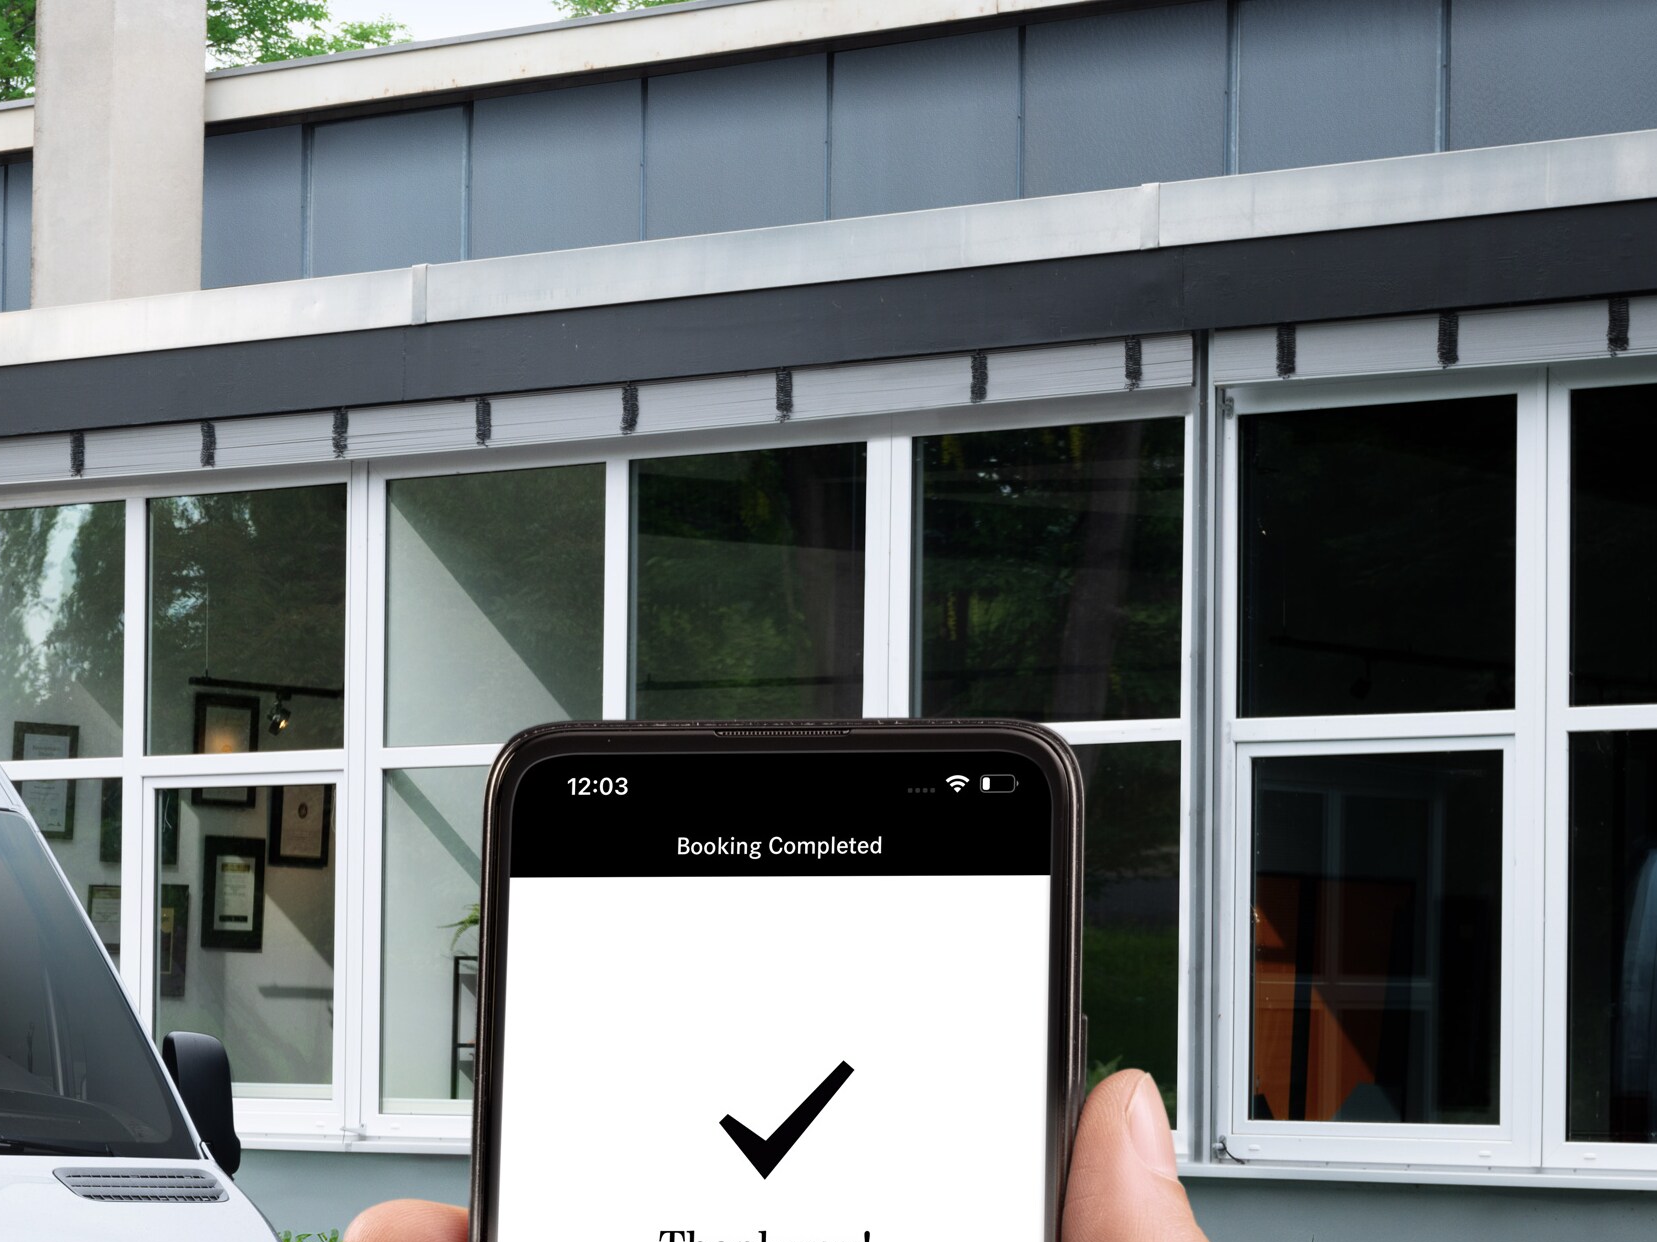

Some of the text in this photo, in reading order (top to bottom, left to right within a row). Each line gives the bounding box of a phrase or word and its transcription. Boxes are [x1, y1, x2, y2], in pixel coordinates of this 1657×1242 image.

[567, 777, 628, 796] 12:03
[677, 835, 882, 860] Booking Completed
